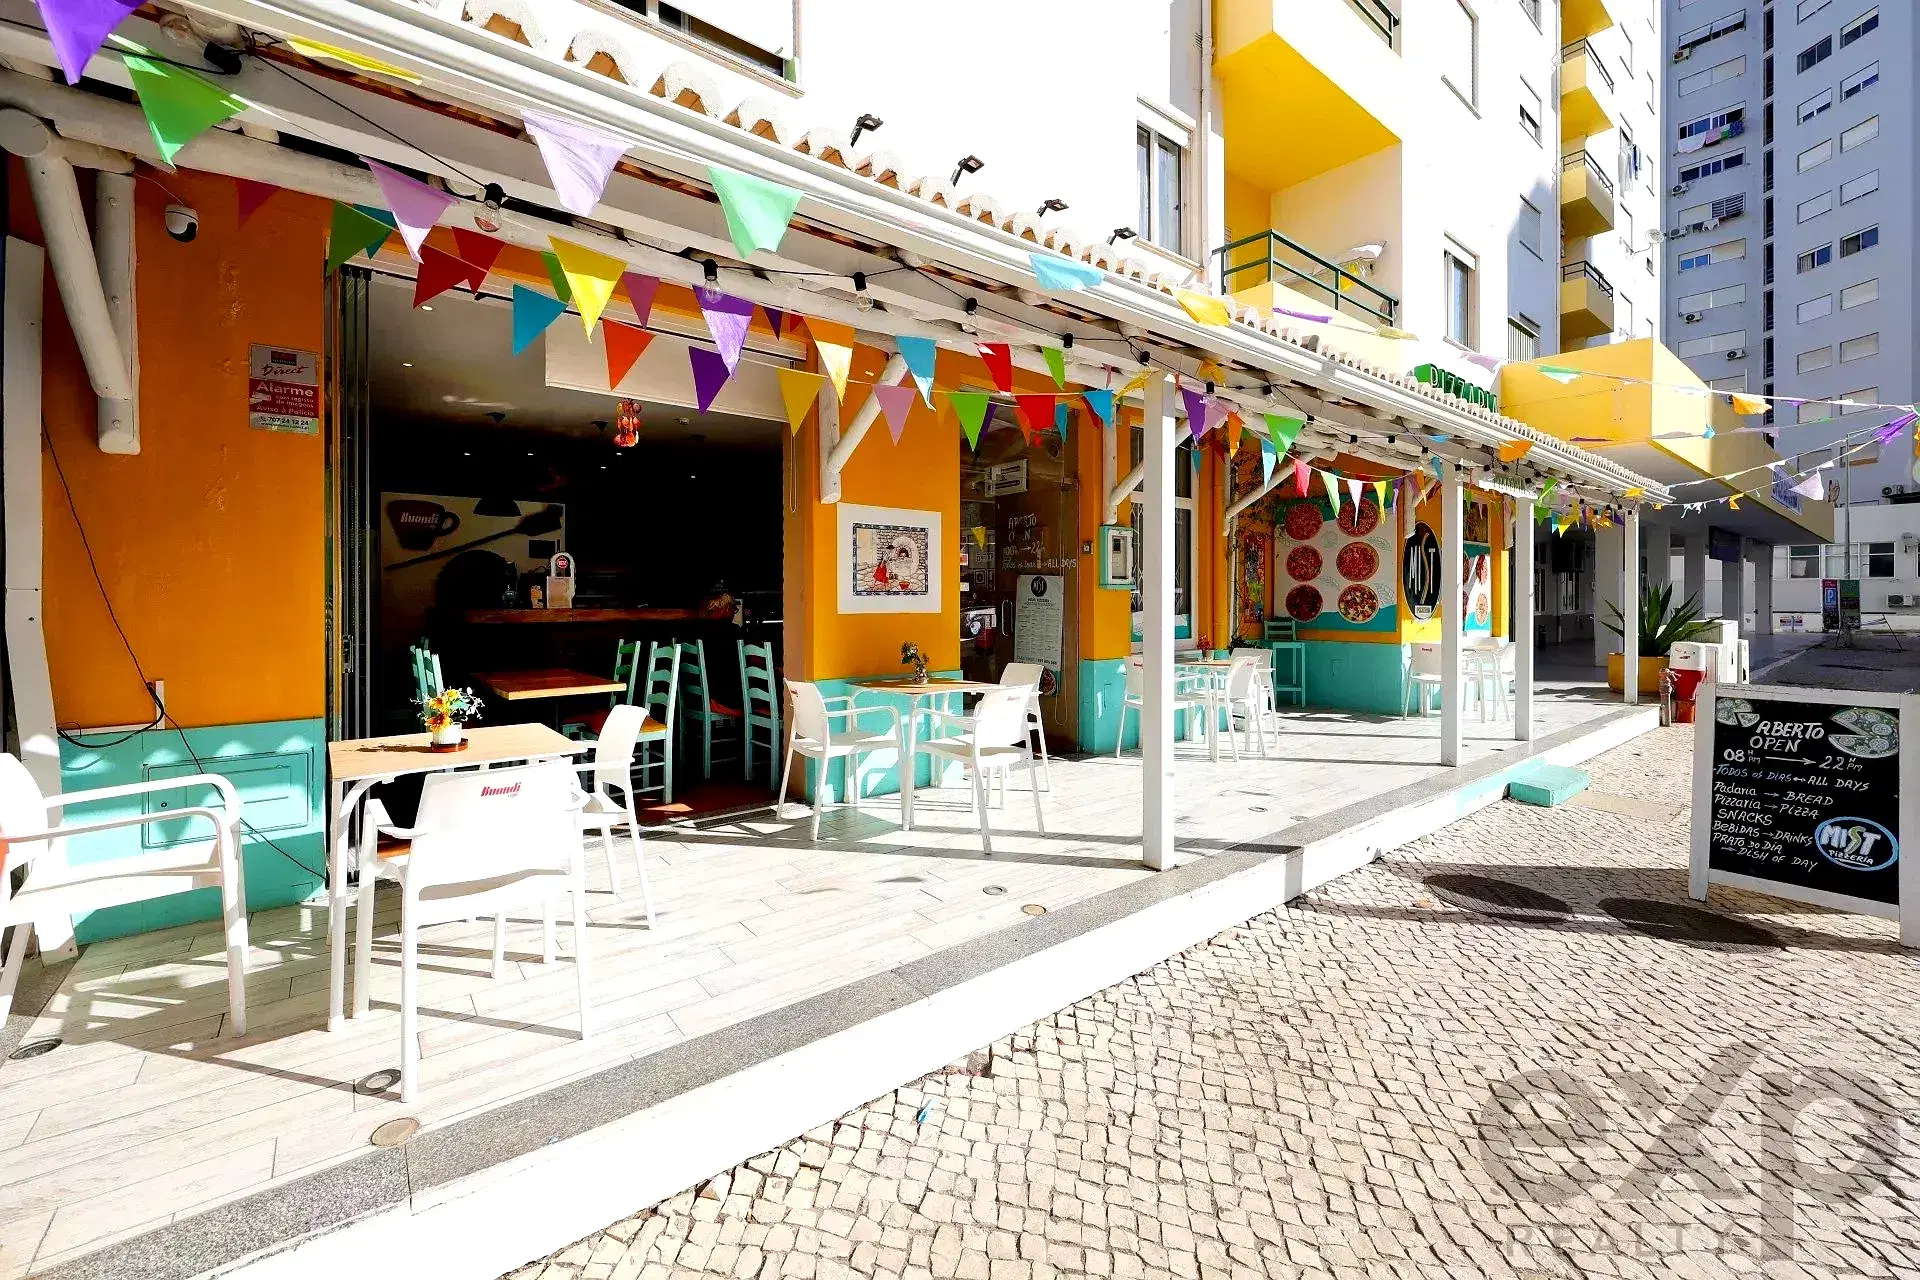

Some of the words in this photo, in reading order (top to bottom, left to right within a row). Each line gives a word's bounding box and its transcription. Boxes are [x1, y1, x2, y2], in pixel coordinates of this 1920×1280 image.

[261, 364, 309, 377] Direct
[256, 381, 314, 397] Alarme
[256, 404, 279, 413] Aviso
[1408, 532, 1436, 605] MIST
[1756, 720, 1825, 740] ABERTO
[1749, 735, 1802, 753] OPEN
[1723, 748, 1746, 763] 08
[1819, 755, 1845, 771] 22
[1807, 775, 1828, 786] ALL
[1834, 778, 1870, 791] DAYS
[1714, 782, 1757, 796] Padaria
[1783, 791, 1834, 806] BREAD
[1715, 794, 1761, 809] Pizzaria
[1717, 808, 1773, 826] SNACKS
[1712, 832, 1745, 846] PRATO
[1820, 824, 1882, 855] MIST
[1791, 857, 1818, 873] DAY
